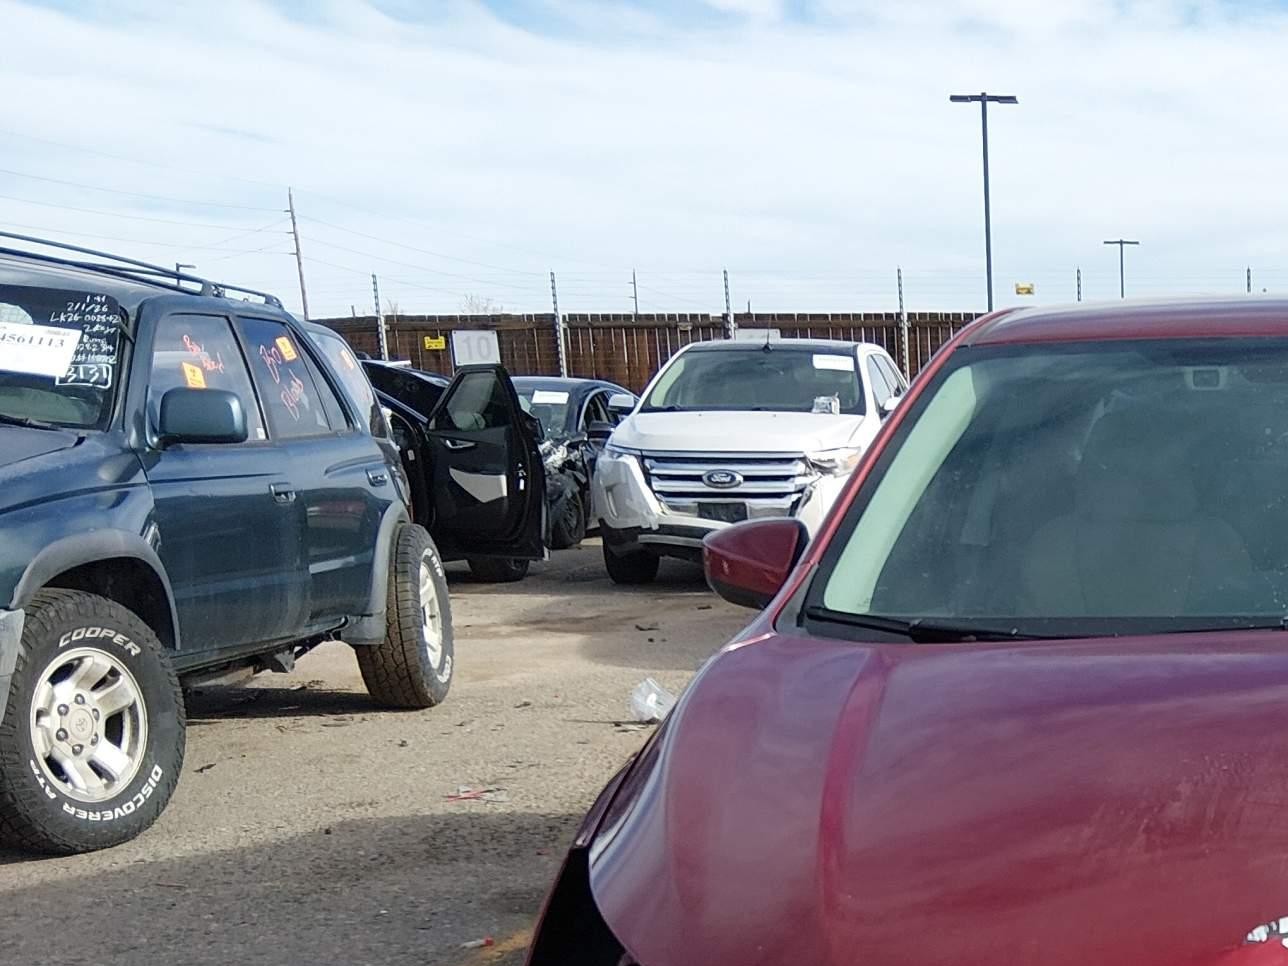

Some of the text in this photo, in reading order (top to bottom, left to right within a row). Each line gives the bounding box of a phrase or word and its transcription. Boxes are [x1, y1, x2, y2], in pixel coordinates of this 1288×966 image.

[463, 335, 492, 360] 10
[59, 627, 141, 657] COOPER
[62, 764, 163, 821] DISCOVERER
